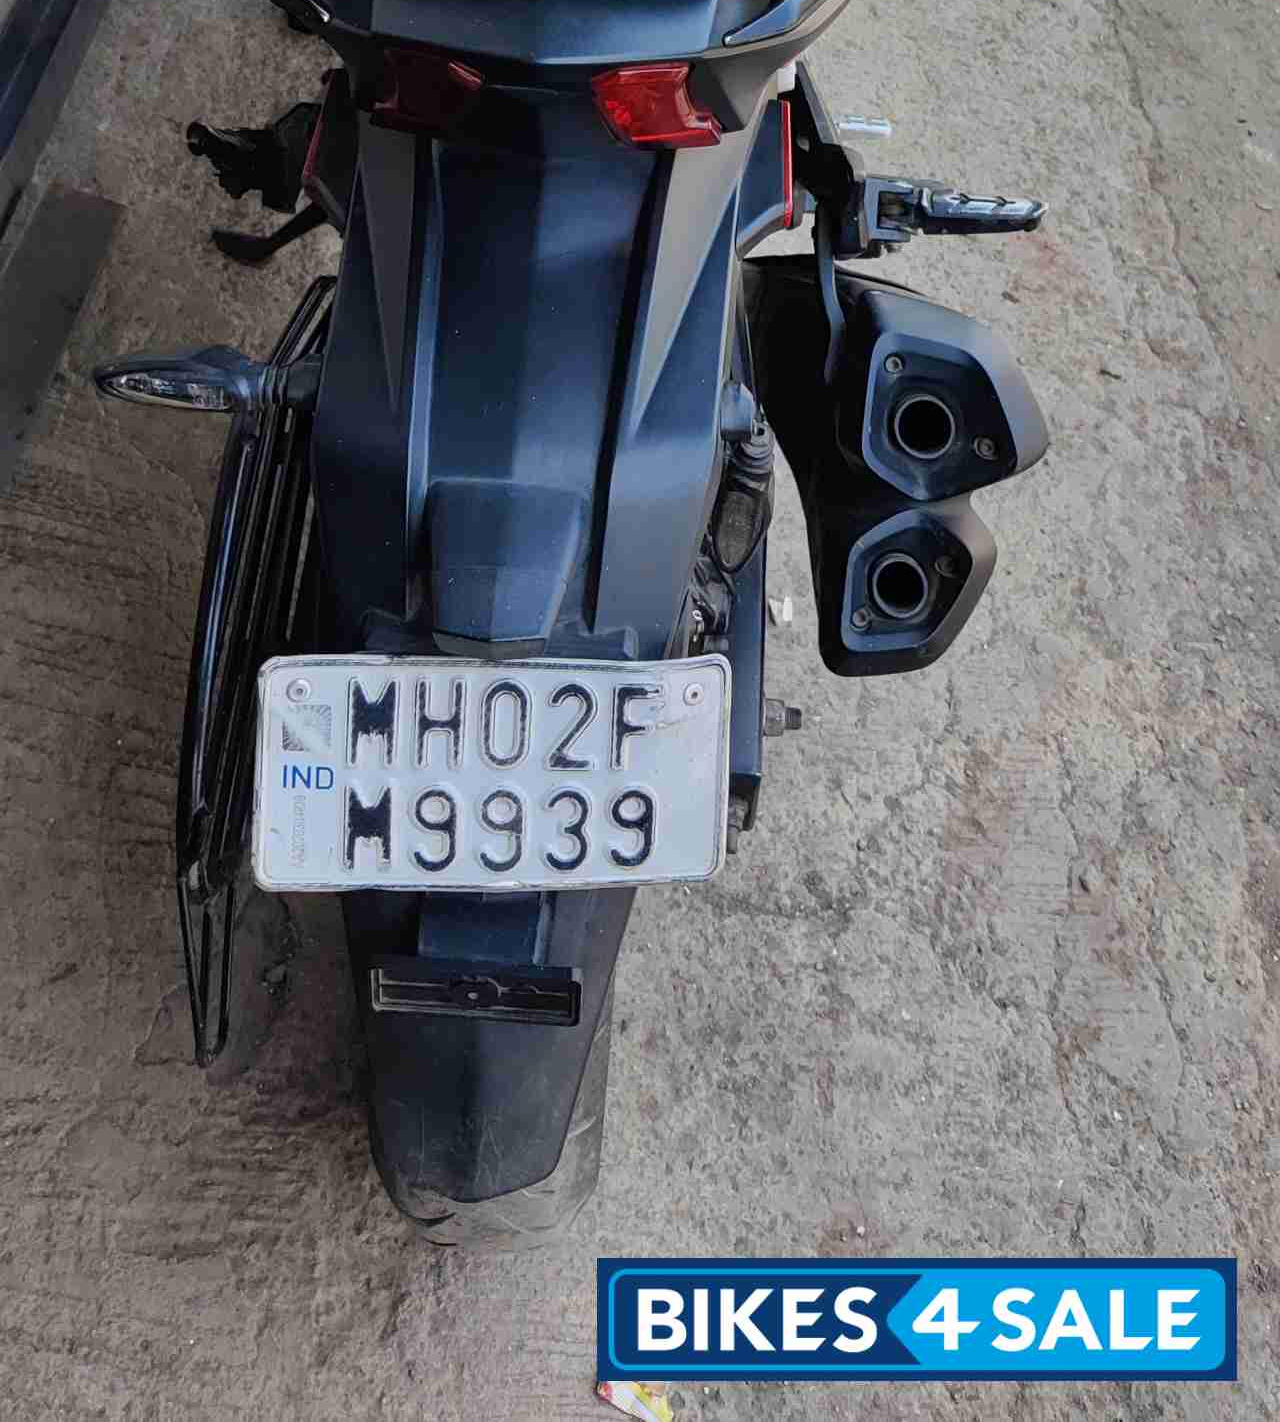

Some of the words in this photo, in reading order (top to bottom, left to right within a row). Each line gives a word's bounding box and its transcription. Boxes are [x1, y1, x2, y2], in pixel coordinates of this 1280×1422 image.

[347, 676, 664, 771] MH02F
[282, 764, 334, 790] IND
[342, 786, 658, 873] M9939
